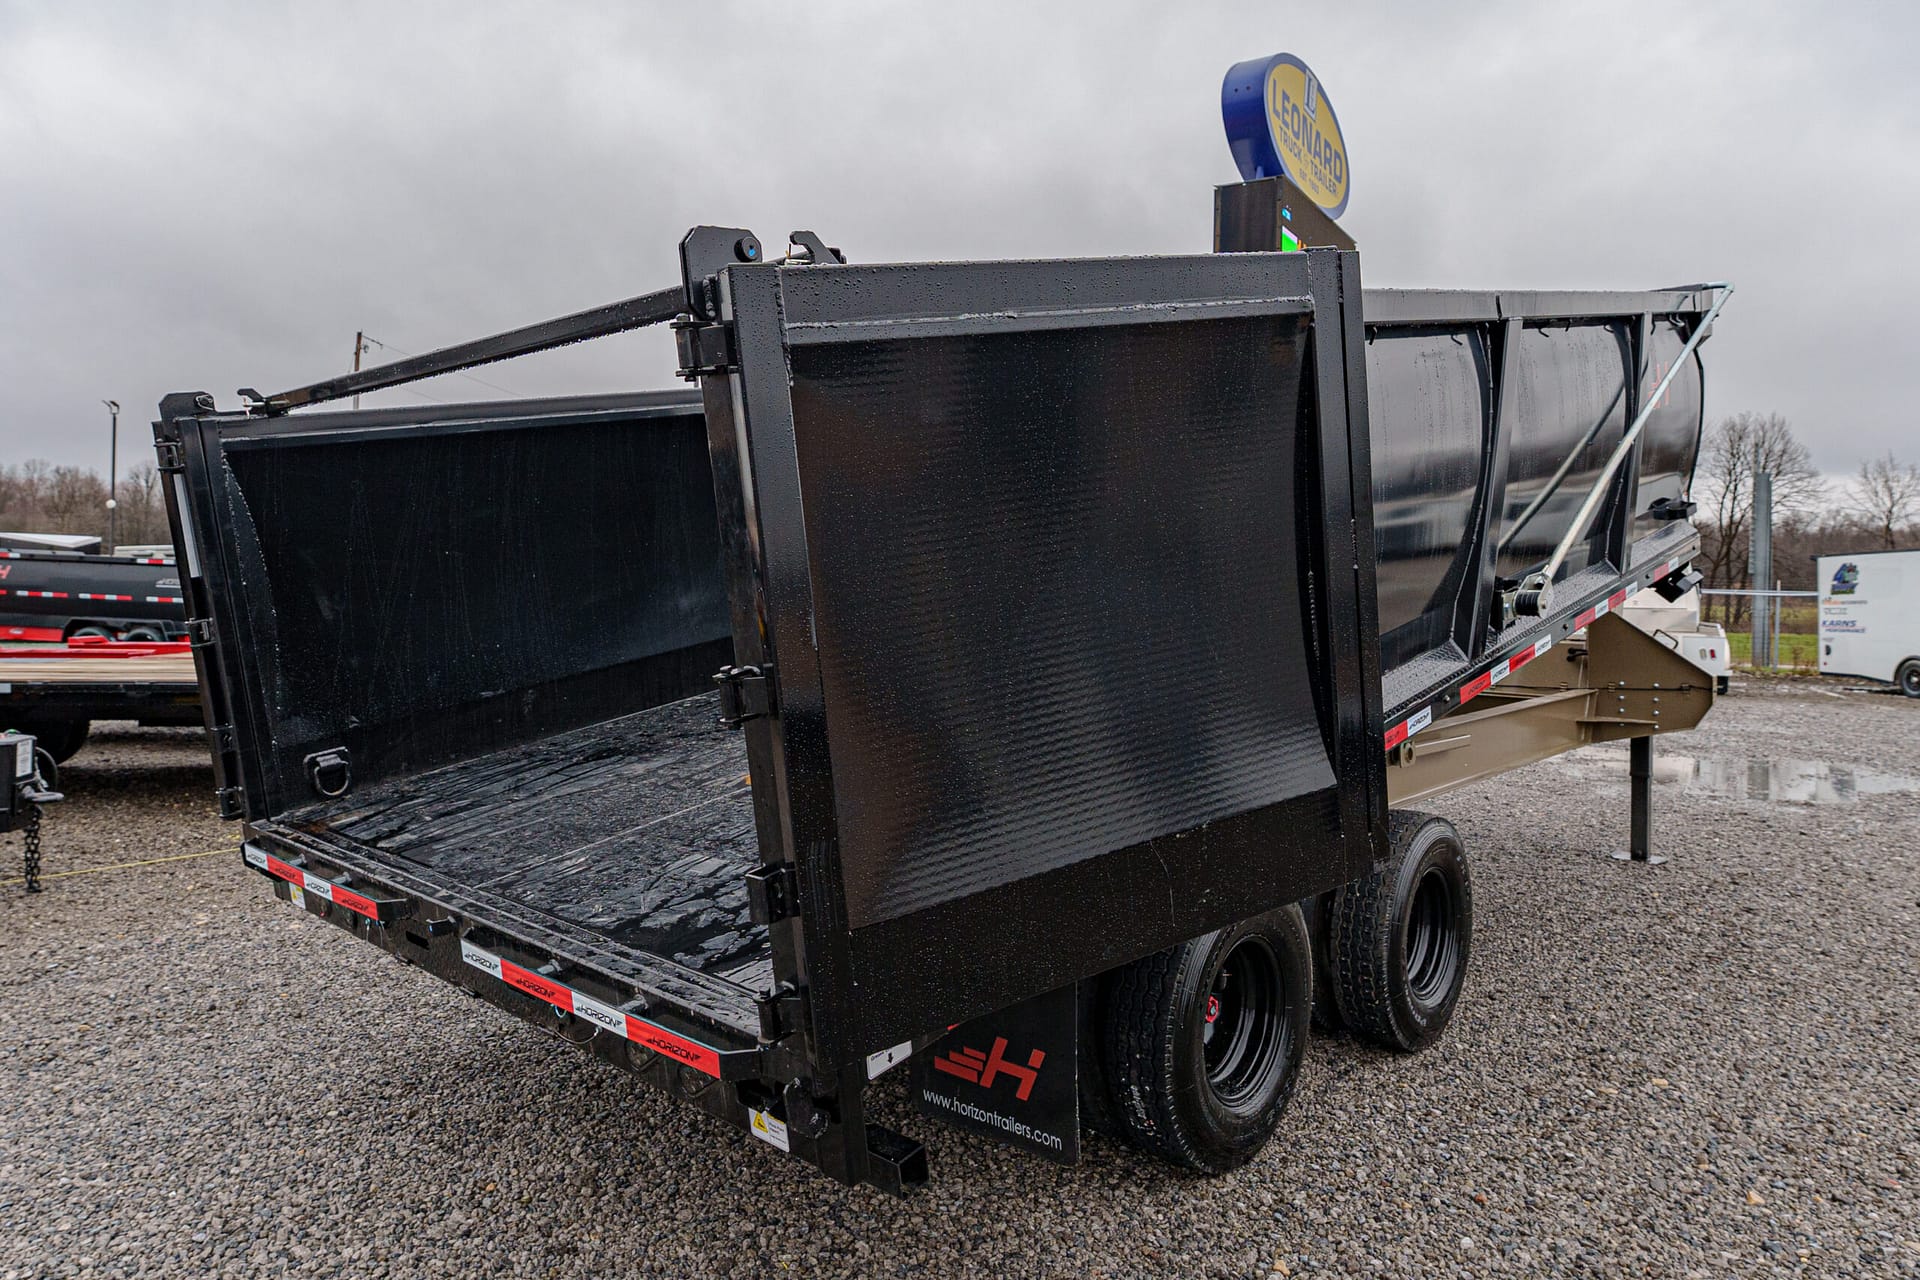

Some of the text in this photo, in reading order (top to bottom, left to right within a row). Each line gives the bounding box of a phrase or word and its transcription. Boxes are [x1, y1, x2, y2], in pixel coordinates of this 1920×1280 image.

[1271, 79, 1343, 184] LEONARD
[1279, 126, 1303, 162] TRUCK
[1310, 159, 1337, 195] TRAILER
[1822, 620, 1857, 628] KARNS
[464, 951, 500, 971] HORIZON
[515, 978, 556, 999] HORIZON
[576, 1004, 623, 1028] HORIZON
[645, 1036, 702, 1062] HORIZON
[923, 1089, 1063, 1151] www.horizontrailers.com
